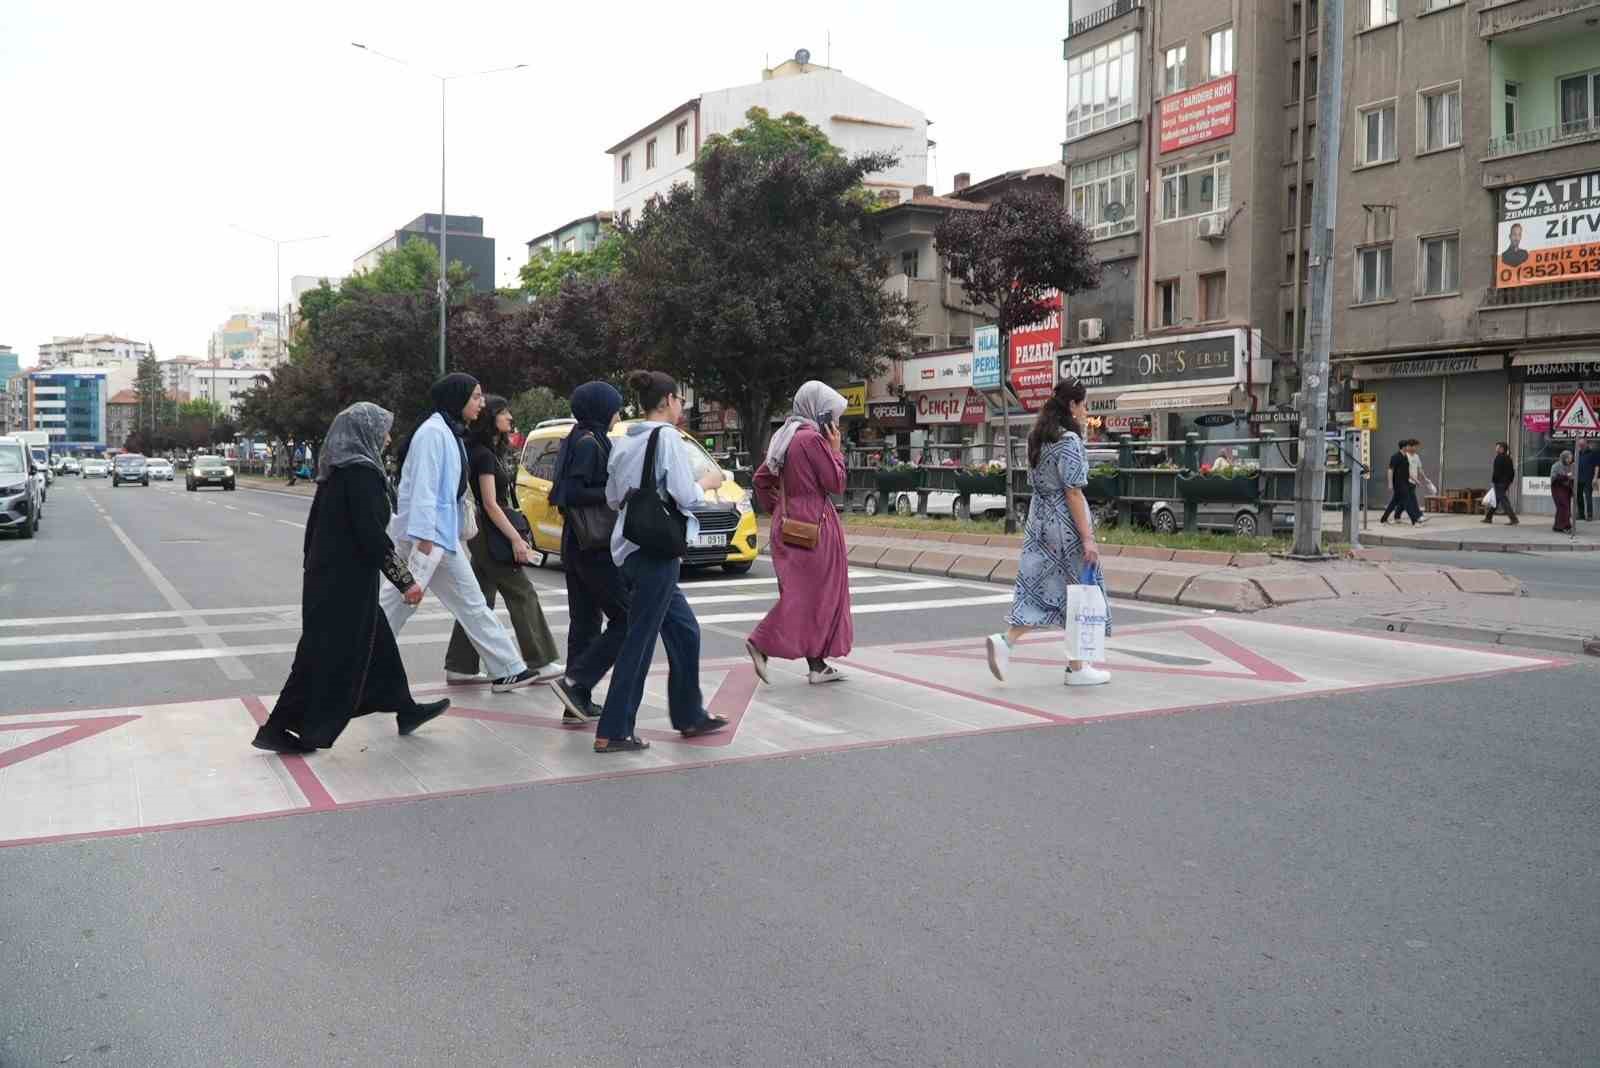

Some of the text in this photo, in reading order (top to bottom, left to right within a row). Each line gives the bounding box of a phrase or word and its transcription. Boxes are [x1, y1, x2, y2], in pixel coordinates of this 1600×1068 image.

[1505, 206, 1537, 220] ZEMİN
[1536, 248, 1572, 263] DENİZ
[1517, 261, 1565, 281] (352)
[1015, 342, 1054, 364] PAZARI
[1059, 354, 1113, 379] GÖZDE
[1527, 362, 1576, 376] HARMAN
